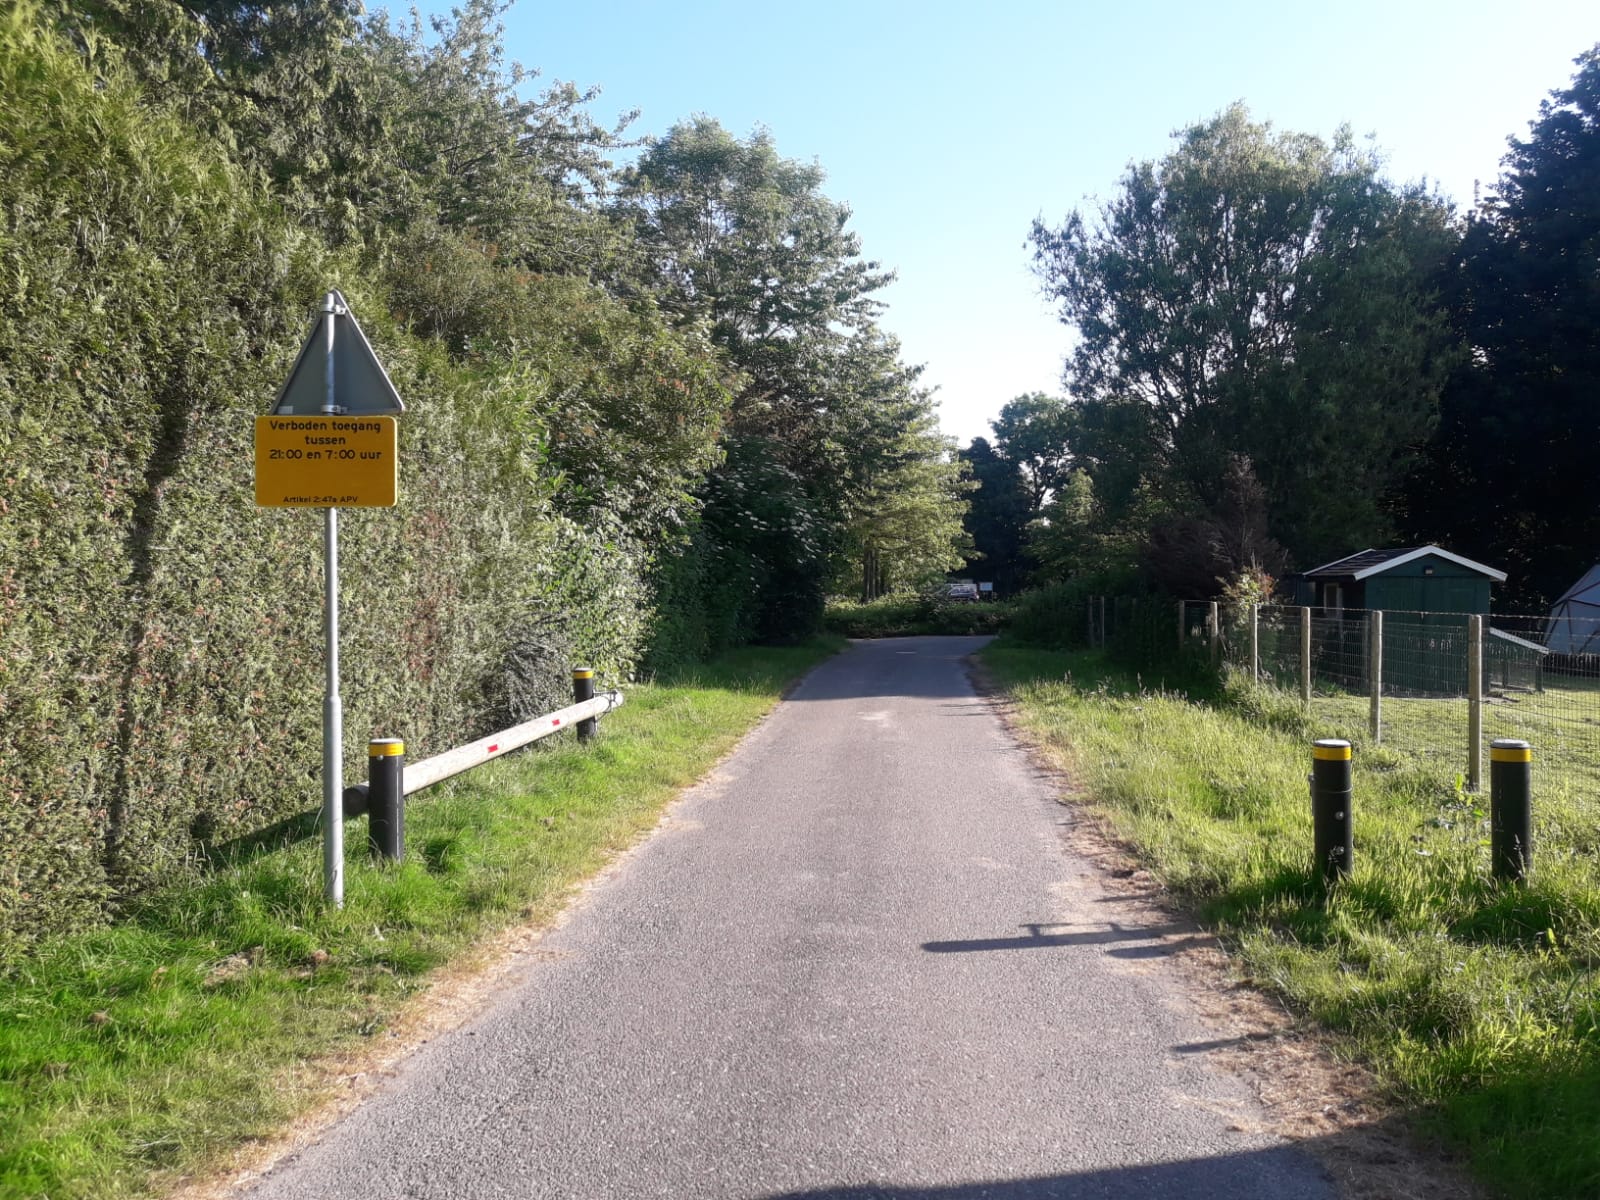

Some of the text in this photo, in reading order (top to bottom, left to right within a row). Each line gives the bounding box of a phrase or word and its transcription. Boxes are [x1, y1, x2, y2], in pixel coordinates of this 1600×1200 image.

[270, 420, 381, 433] Verboden toegang
[304, 435, 346, 445] tussen
[269, 449, 382, 459] 21:00 en 7:00 uur
[283, 495, 311, 503] Artikel
[340, 495, 359, 503] APV
